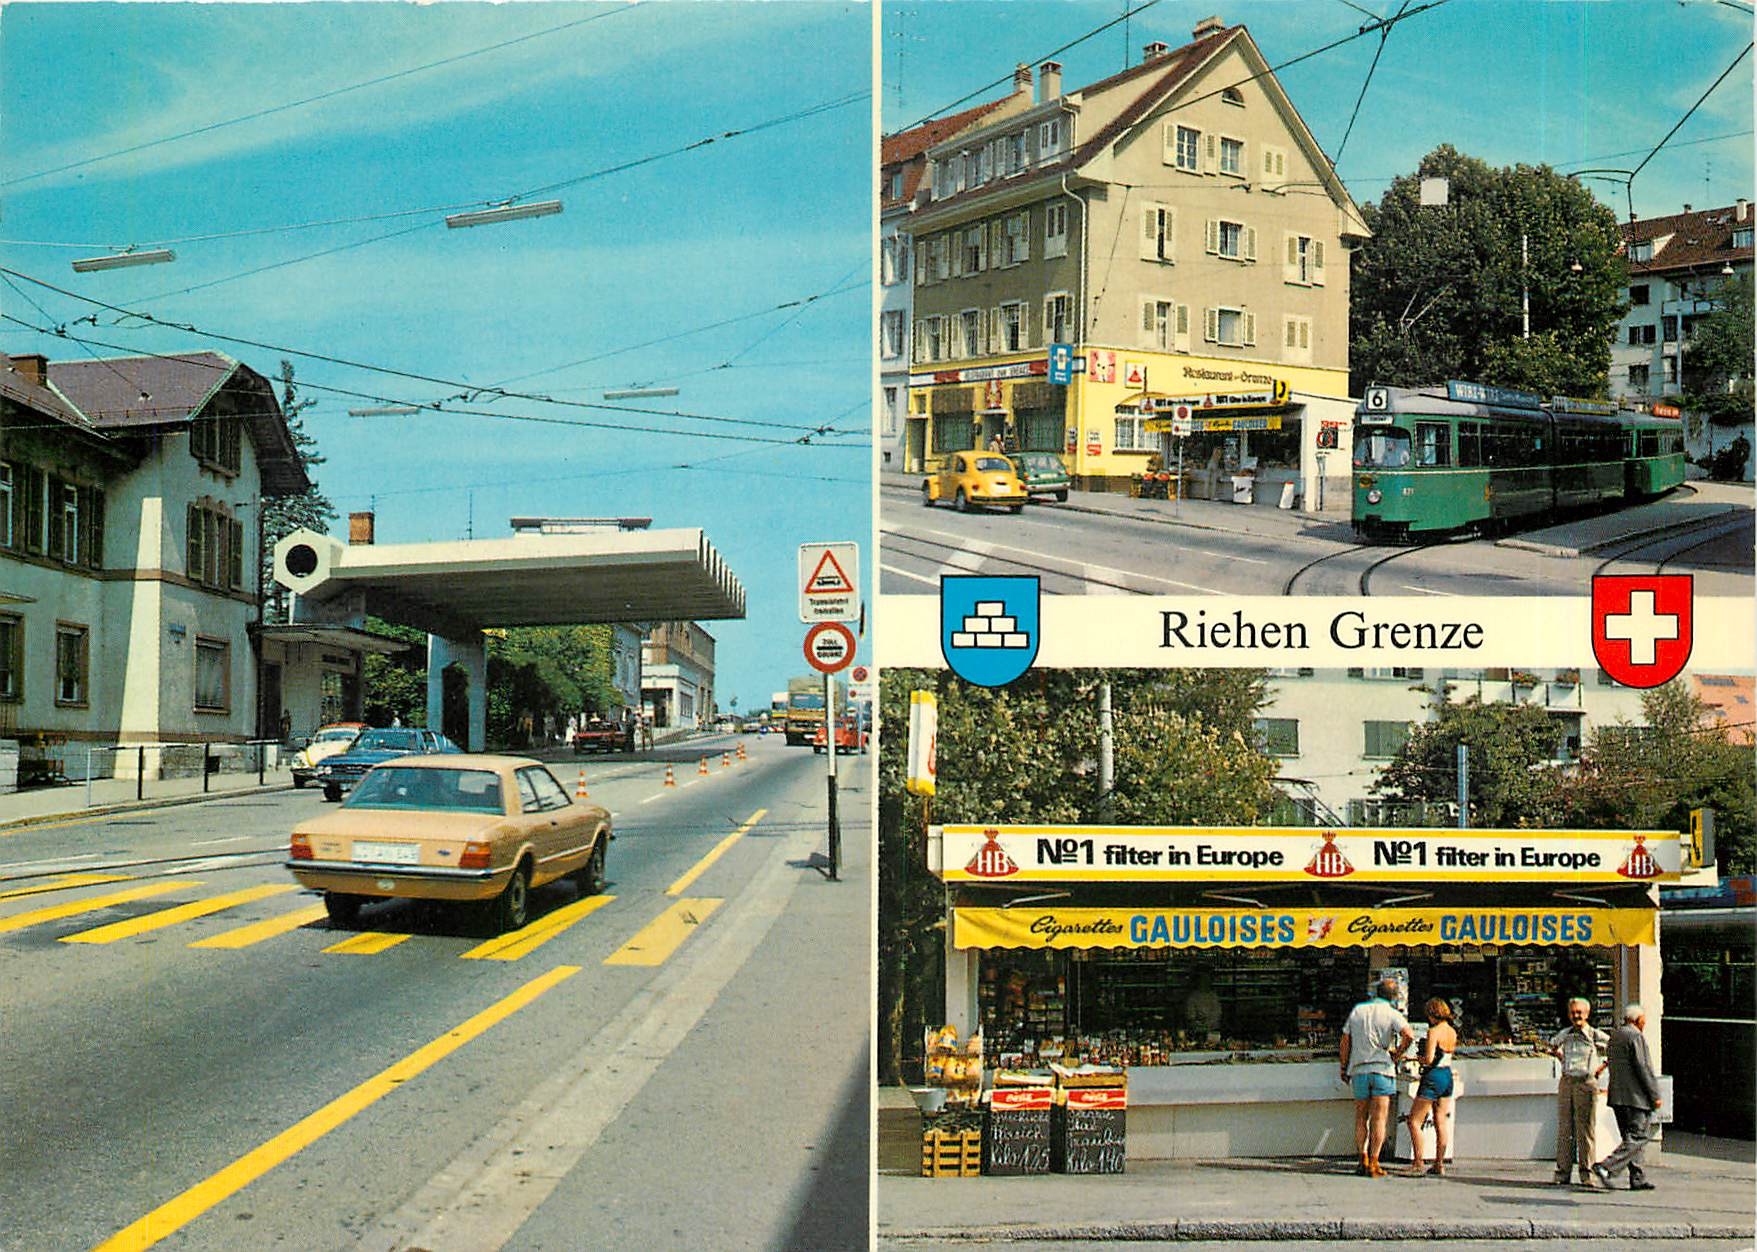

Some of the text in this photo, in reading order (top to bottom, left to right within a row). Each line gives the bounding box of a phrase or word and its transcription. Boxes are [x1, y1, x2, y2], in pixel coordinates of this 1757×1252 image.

[1373, 391, 1383, 407] 6
[977, 849, 1009, 874] HB
[1103, 844, 1163, 866] filter
[1168, 845, 1191, 866] in
[1196, 844, 1284, 869] Europe
[1315, 849, 1346, 876] HB
[1434, 846, 1490, 867] filter
[1494, 847, 1516, 867] in
[1520, 847, 1601, 870] Europe
[1627, 853, 1654, 879] HB
[1030, 914, 1295, 943] Cigarettes GAULOISES
[1347, 914, 1593, 942] Cigarettes GAULOISES
